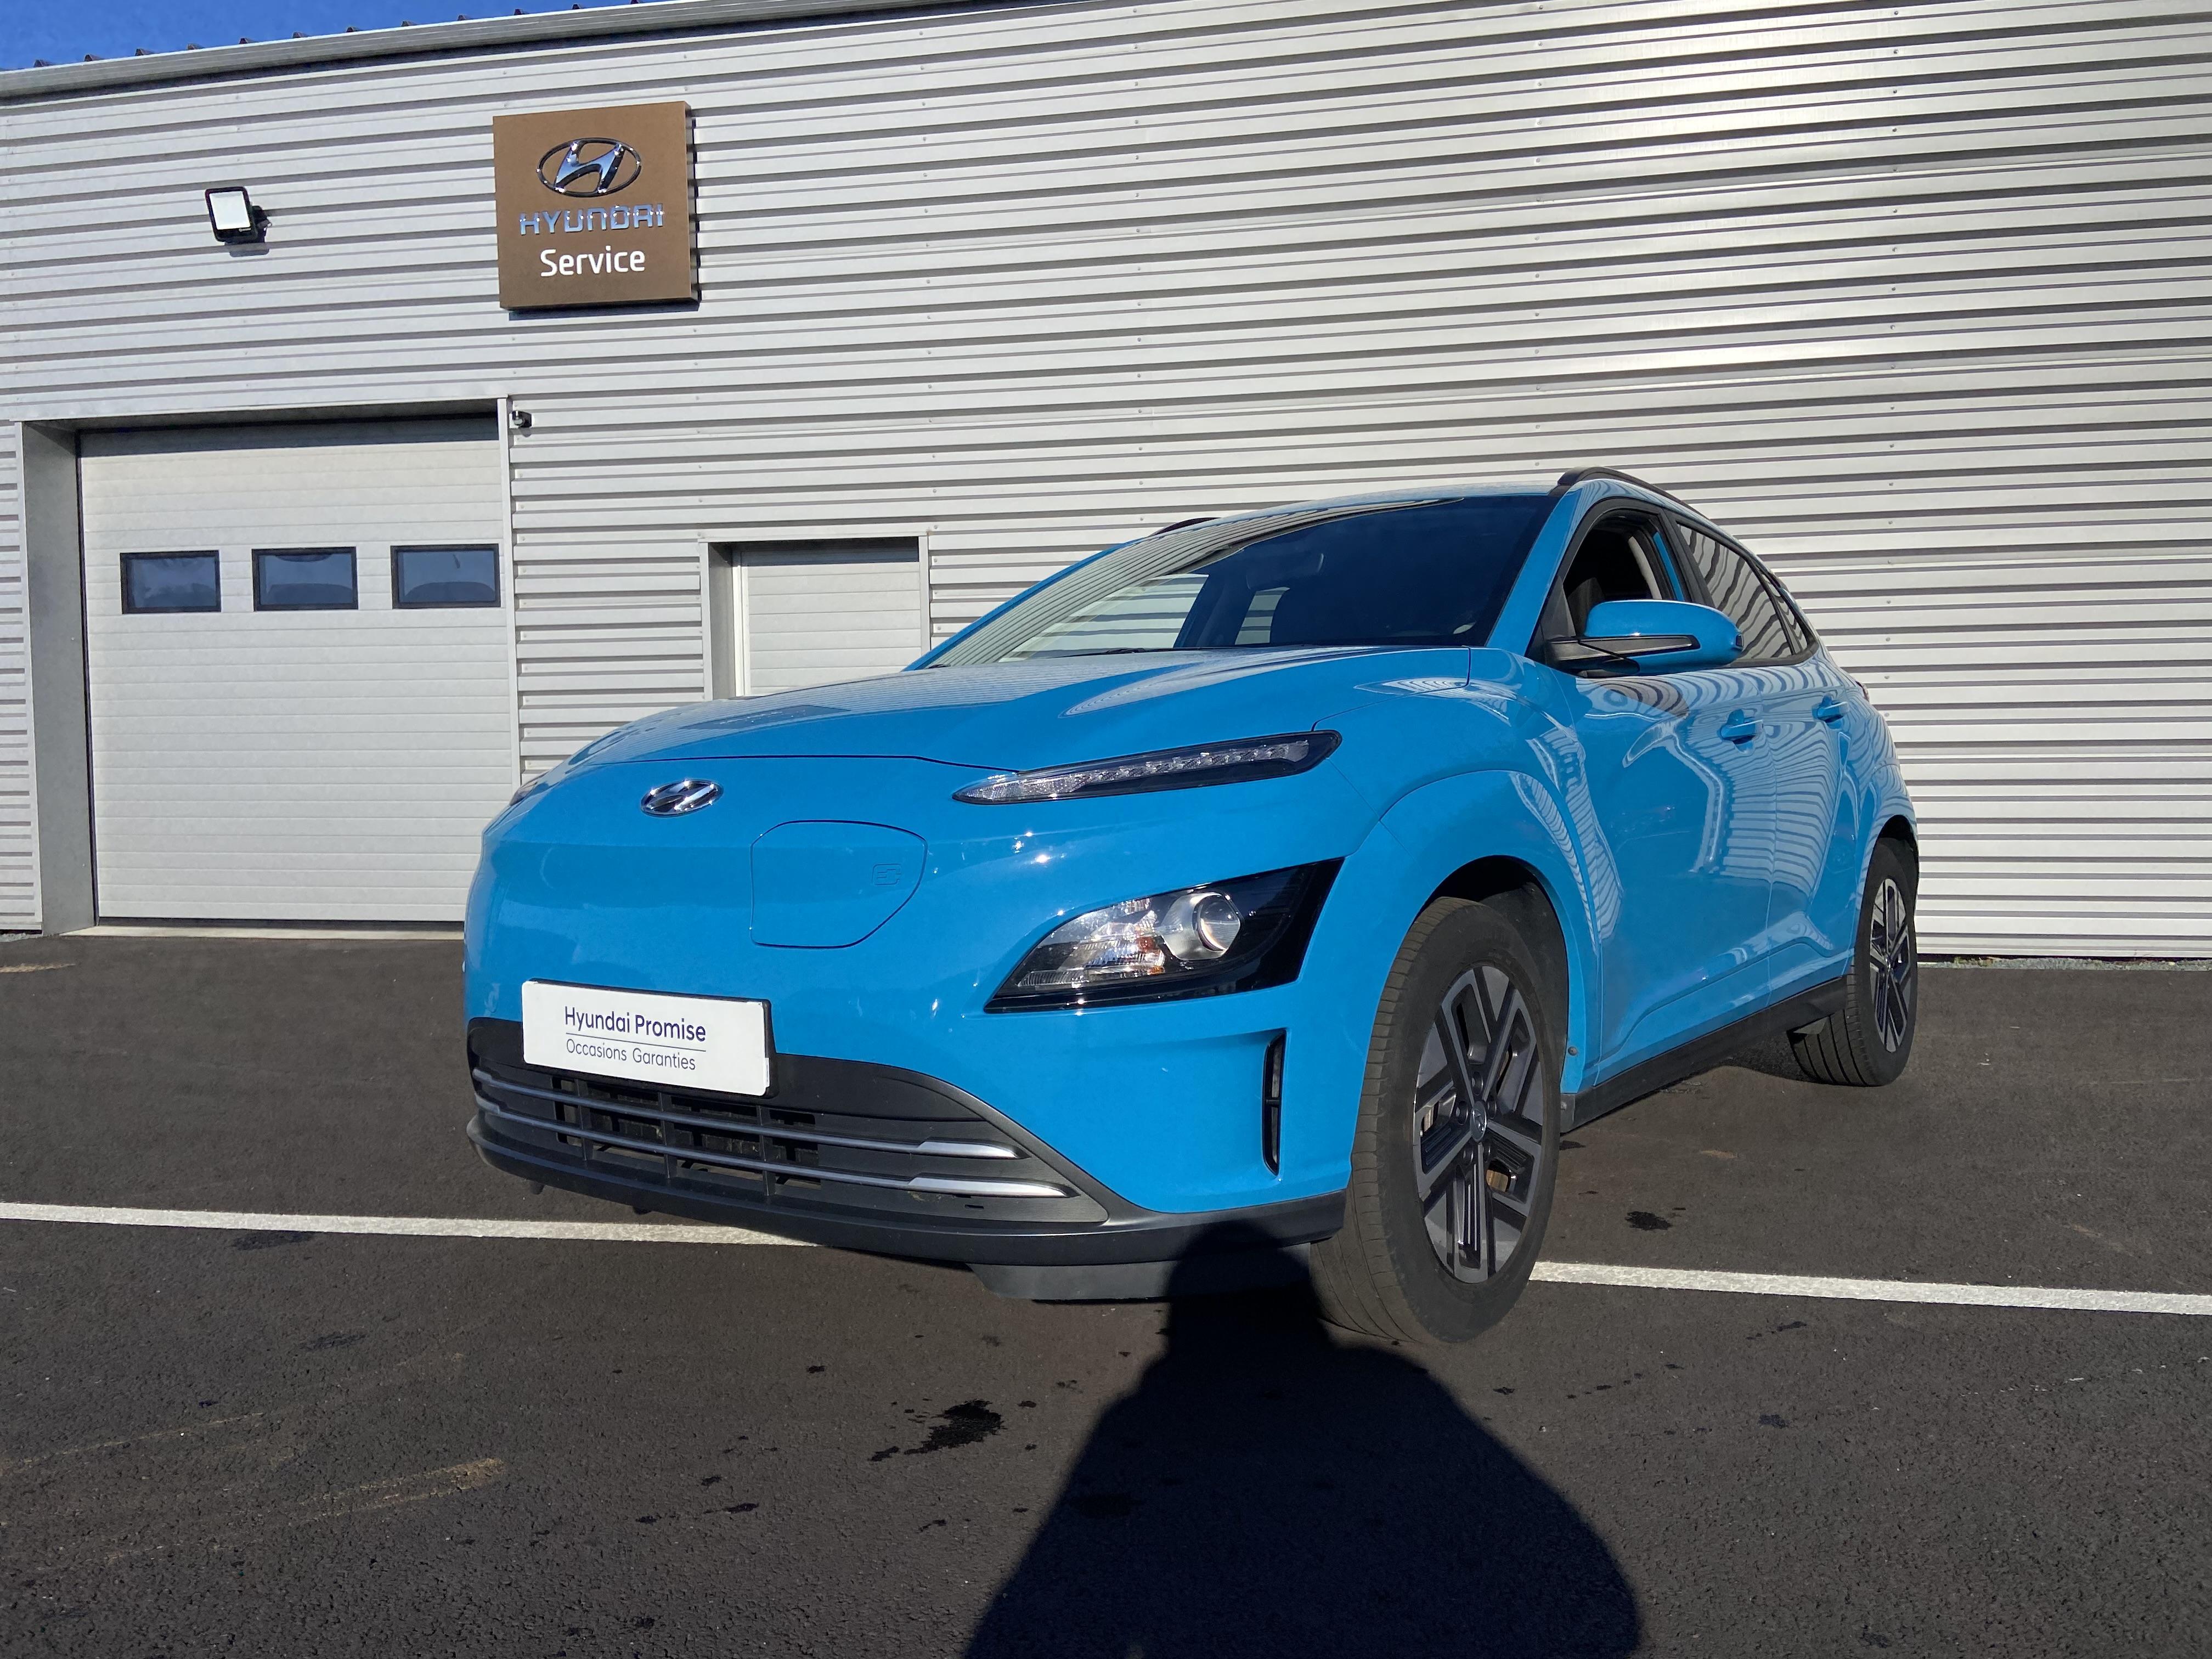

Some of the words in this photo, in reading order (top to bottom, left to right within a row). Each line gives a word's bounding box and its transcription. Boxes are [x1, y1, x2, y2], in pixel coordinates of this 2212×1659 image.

[519, 204, 663, 235] HYUNDAI
[540, 245, 645, 276] Service
[565, 1006, 630, 1032] Hyundai
[635, 1014, 706, 1041] Promise
[566, 1039, 627, 1061] Occasions
[633, 1048, 696, 1070] Garanties
